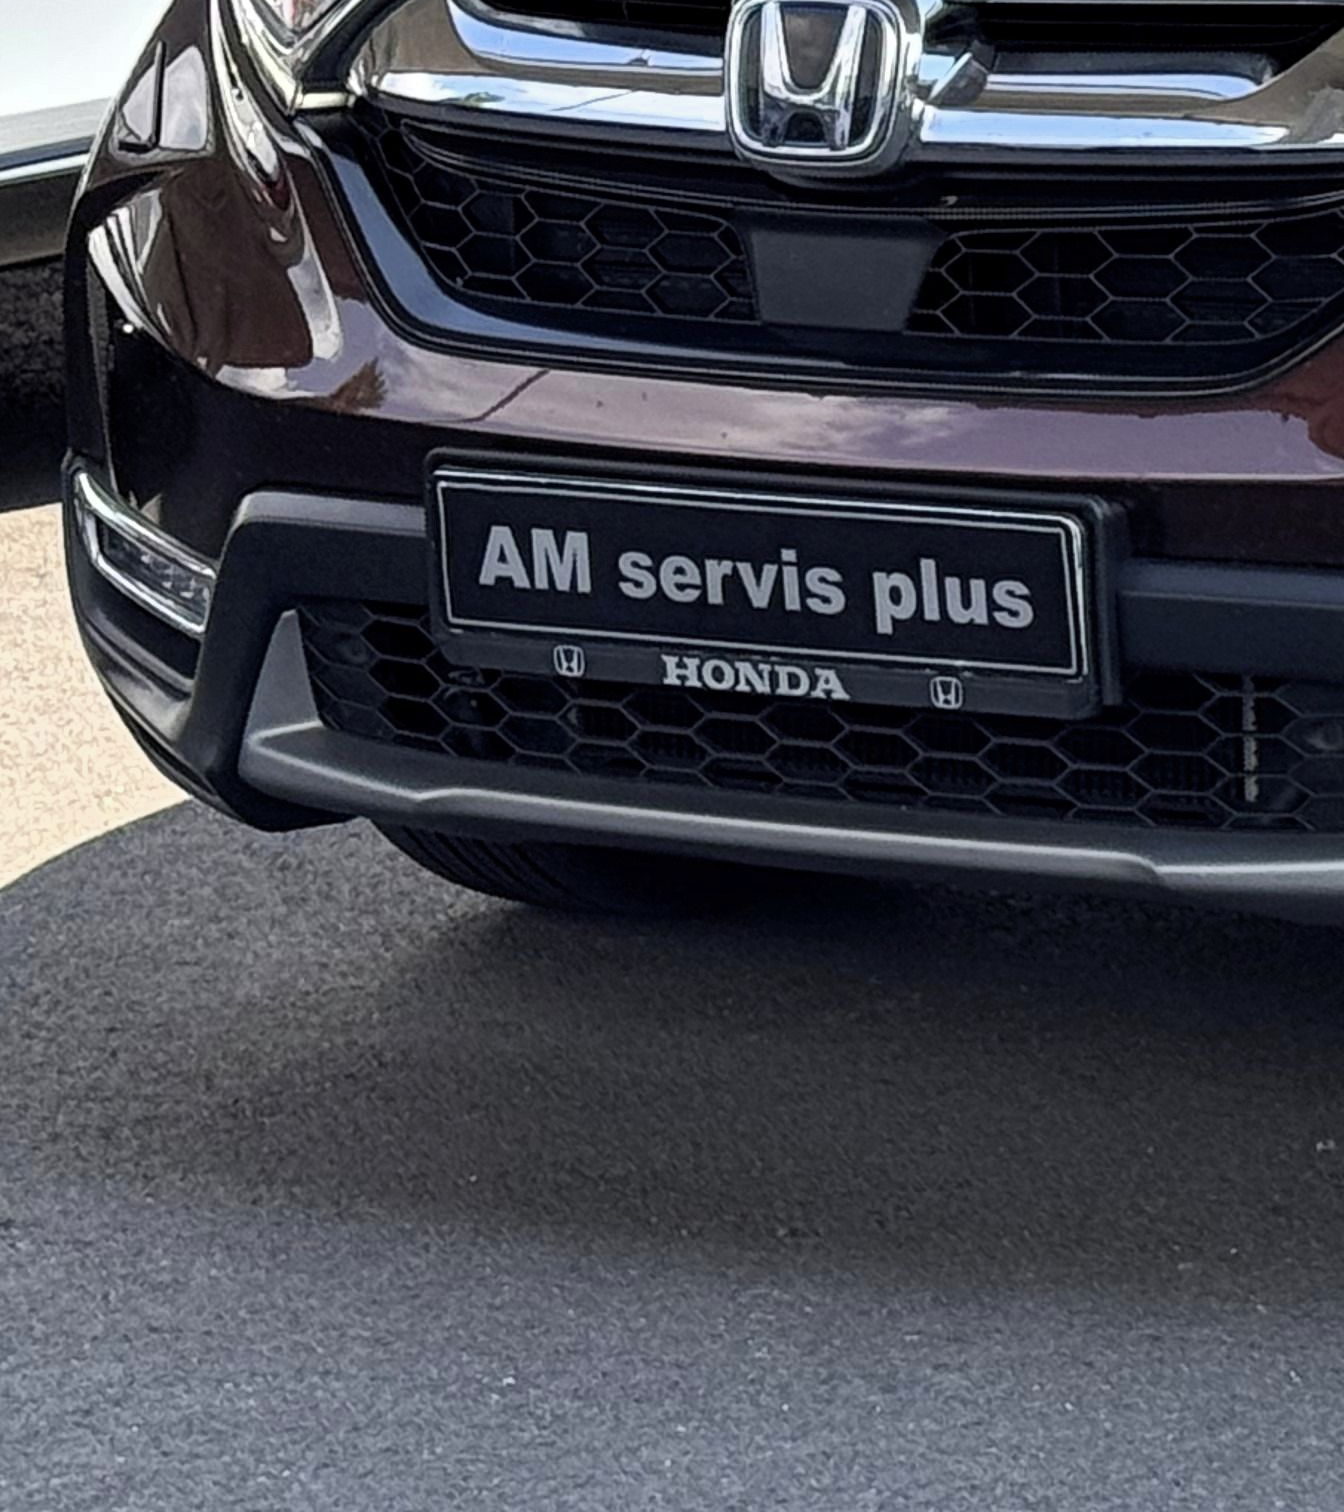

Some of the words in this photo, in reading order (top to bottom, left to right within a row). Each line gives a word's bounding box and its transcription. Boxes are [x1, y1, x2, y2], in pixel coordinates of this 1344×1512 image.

[478, 525, 592, 594] AM
[617, 548, 846, 616] servis
[872, 558, 1034, 636] plus
[661, 654, 850, 700] HONDA
